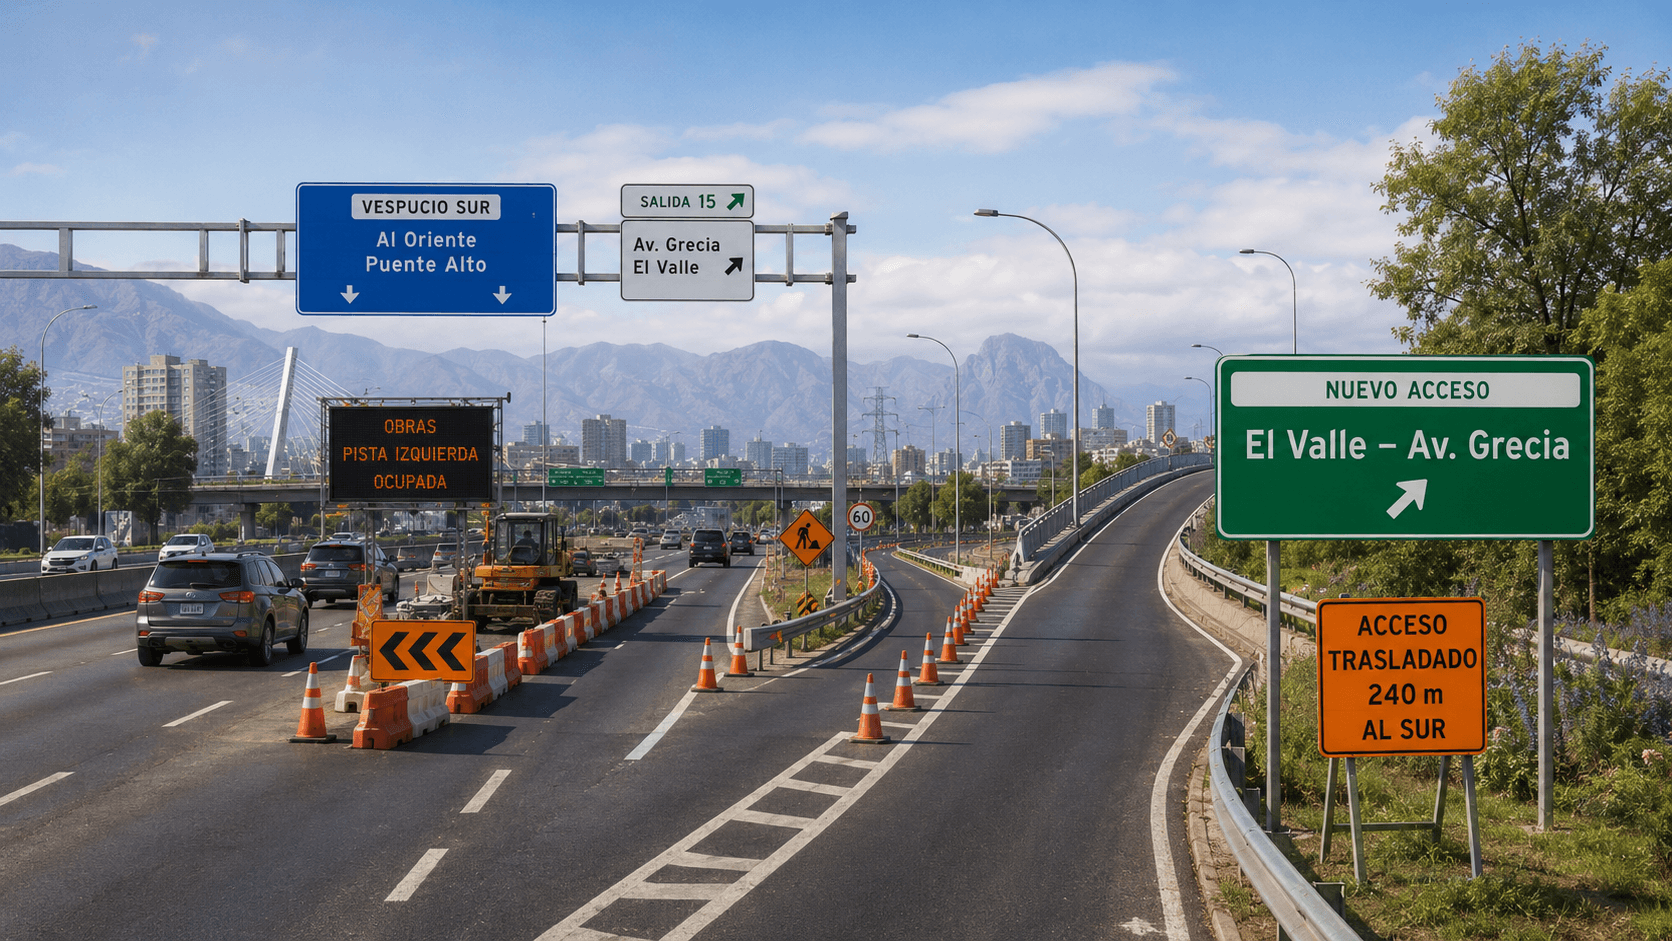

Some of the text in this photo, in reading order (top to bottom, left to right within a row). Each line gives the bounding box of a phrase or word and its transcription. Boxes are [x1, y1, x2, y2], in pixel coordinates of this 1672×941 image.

[362, 200, 490, 214] VESPUCIO SUR
[641, 194, 716, 208] SALIDA 15
[377, 231, 477, 248] Al Oriente
[634, 237, 720, 252] Av. Grecia
[367, 256, 487, 272] Puente Alto
[634, 260, 699, 275] El Valle
[1327, 381, 1489, 399] NUEVO ACCESO
[384, 419, 436, 434] OBRAS
[1246, 429, 1274, 459] El
[1287, 429, 1366, 460] Valle
[1408, 430, 1456, 460] Av.
[1469, 429, 1570, 460] Grecia
[343, 446, 478, 462] PISTA IZQUIERDA
[374, 474, 447, 489] OCUPADA
[852, 510, 871, 524] 60
[1357, 614, 1448, 636] ACCESO
[1328, 648, 1477, 670] TRASLADADO
[1368, 683, 1443, 705] 240 m
[1362, 718, 1446, 740] AL SUR
